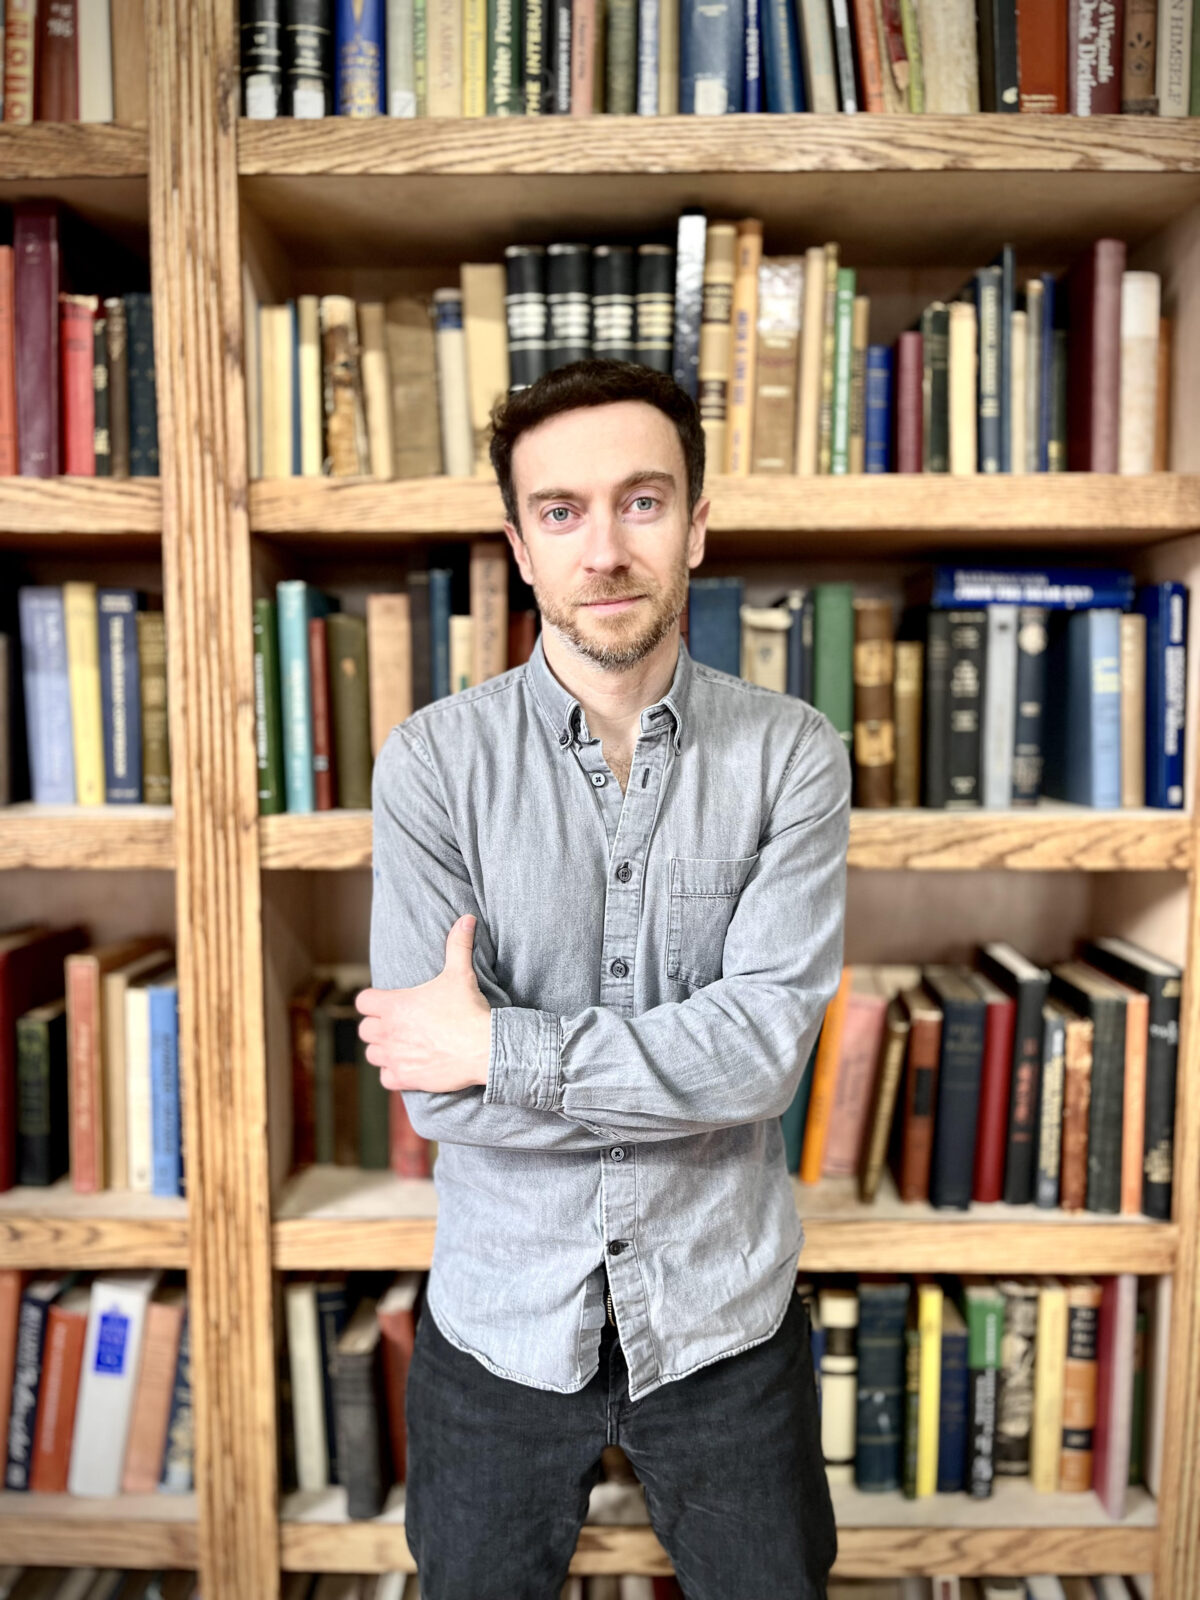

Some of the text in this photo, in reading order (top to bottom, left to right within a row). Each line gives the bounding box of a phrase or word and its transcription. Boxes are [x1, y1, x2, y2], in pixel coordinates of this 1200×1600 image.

[493, 46, 512, 104] White
[1168, 15, 1184, 105] HIMSELF
[525, 80, 541, 116] THE
